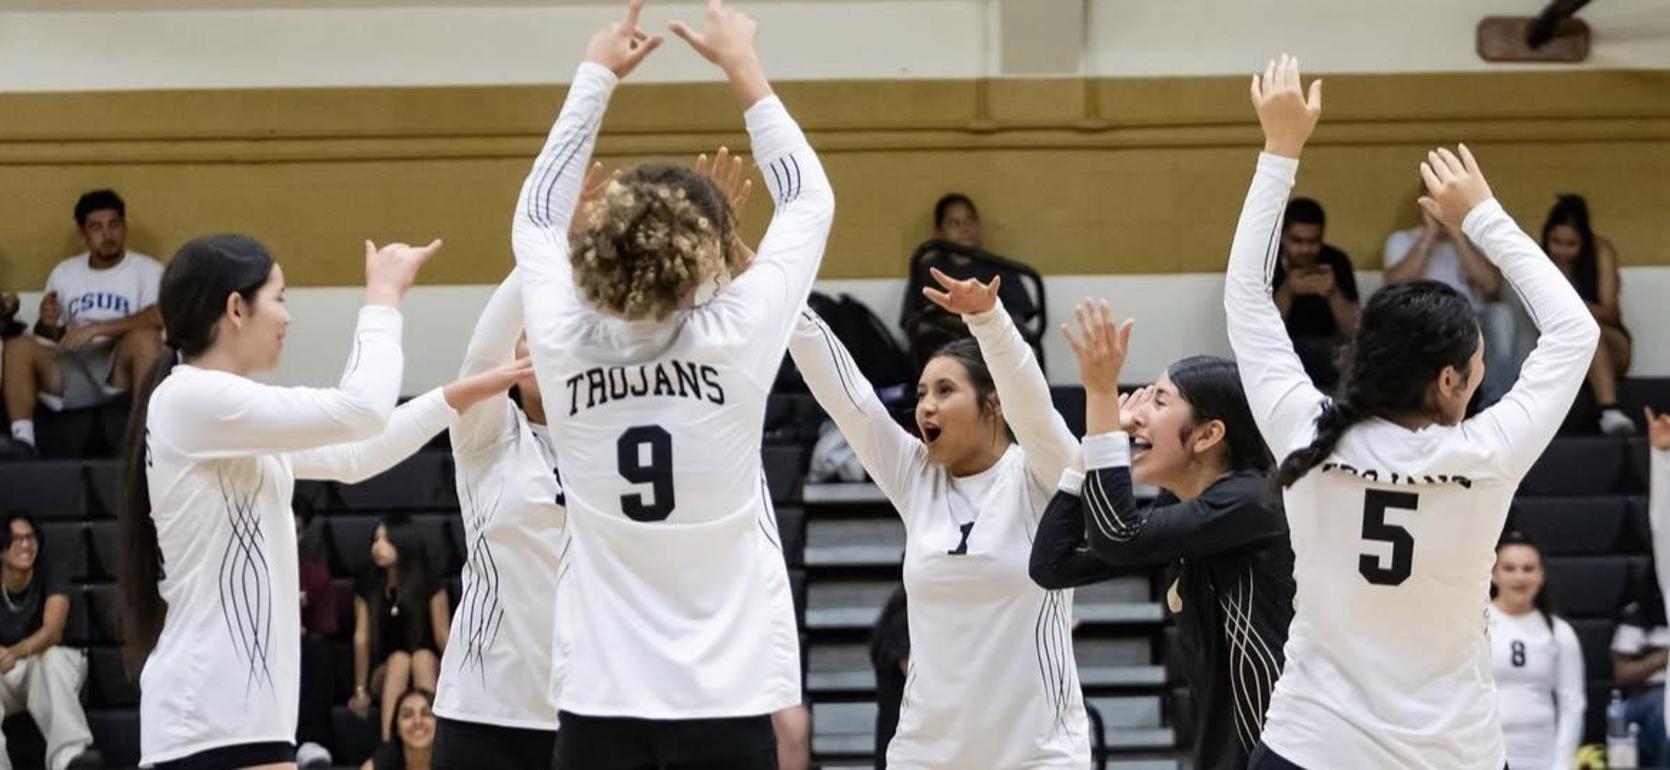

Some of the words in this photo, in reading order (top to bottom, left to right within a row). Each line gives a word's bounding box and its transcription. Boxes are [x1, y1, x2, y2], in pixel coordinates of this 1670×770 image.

[566, 359, 725, 416] TROJANS
[617, 424, 675, 523] 9
[1358, 488, 1419, 586] 5
[1511, 640, 1526, 668] 8
